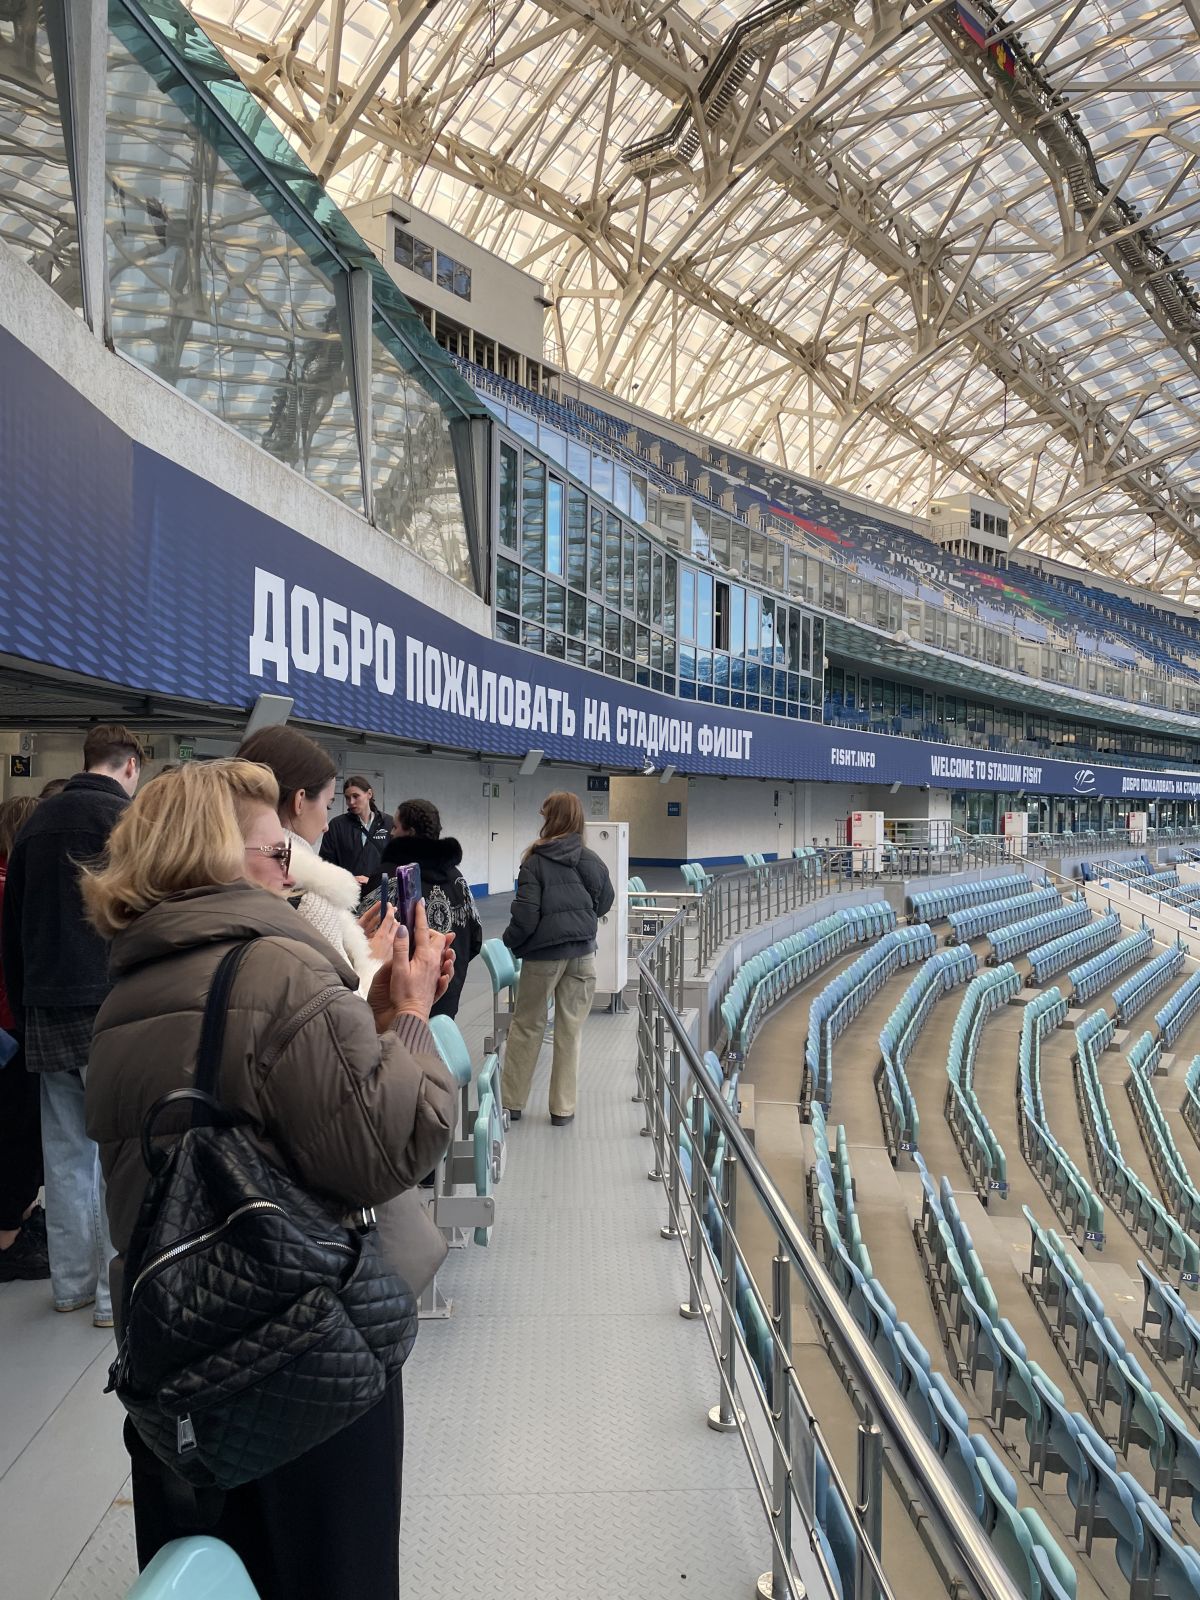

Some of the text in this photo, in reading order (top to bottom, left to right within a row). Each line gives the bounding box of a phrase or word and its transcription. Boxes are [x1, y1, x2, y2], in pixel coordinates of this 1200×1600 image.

[249, 566, 753, 760] ДОБРО ПОЖАЛОВАТЬ НА СТАДИОН ФИШТ
[831, 747, 876, 769] FISHT.INFO
[930, 755, 1043, 784] WELCOME TO STADIUM FISHT
[1122, 776, 1140, 792] ДОБРО
[643, 924, 651, 932] 26
[1086, 1232, 1095, 1240] 21
[1182, 1273, 1192, 1281] 20
